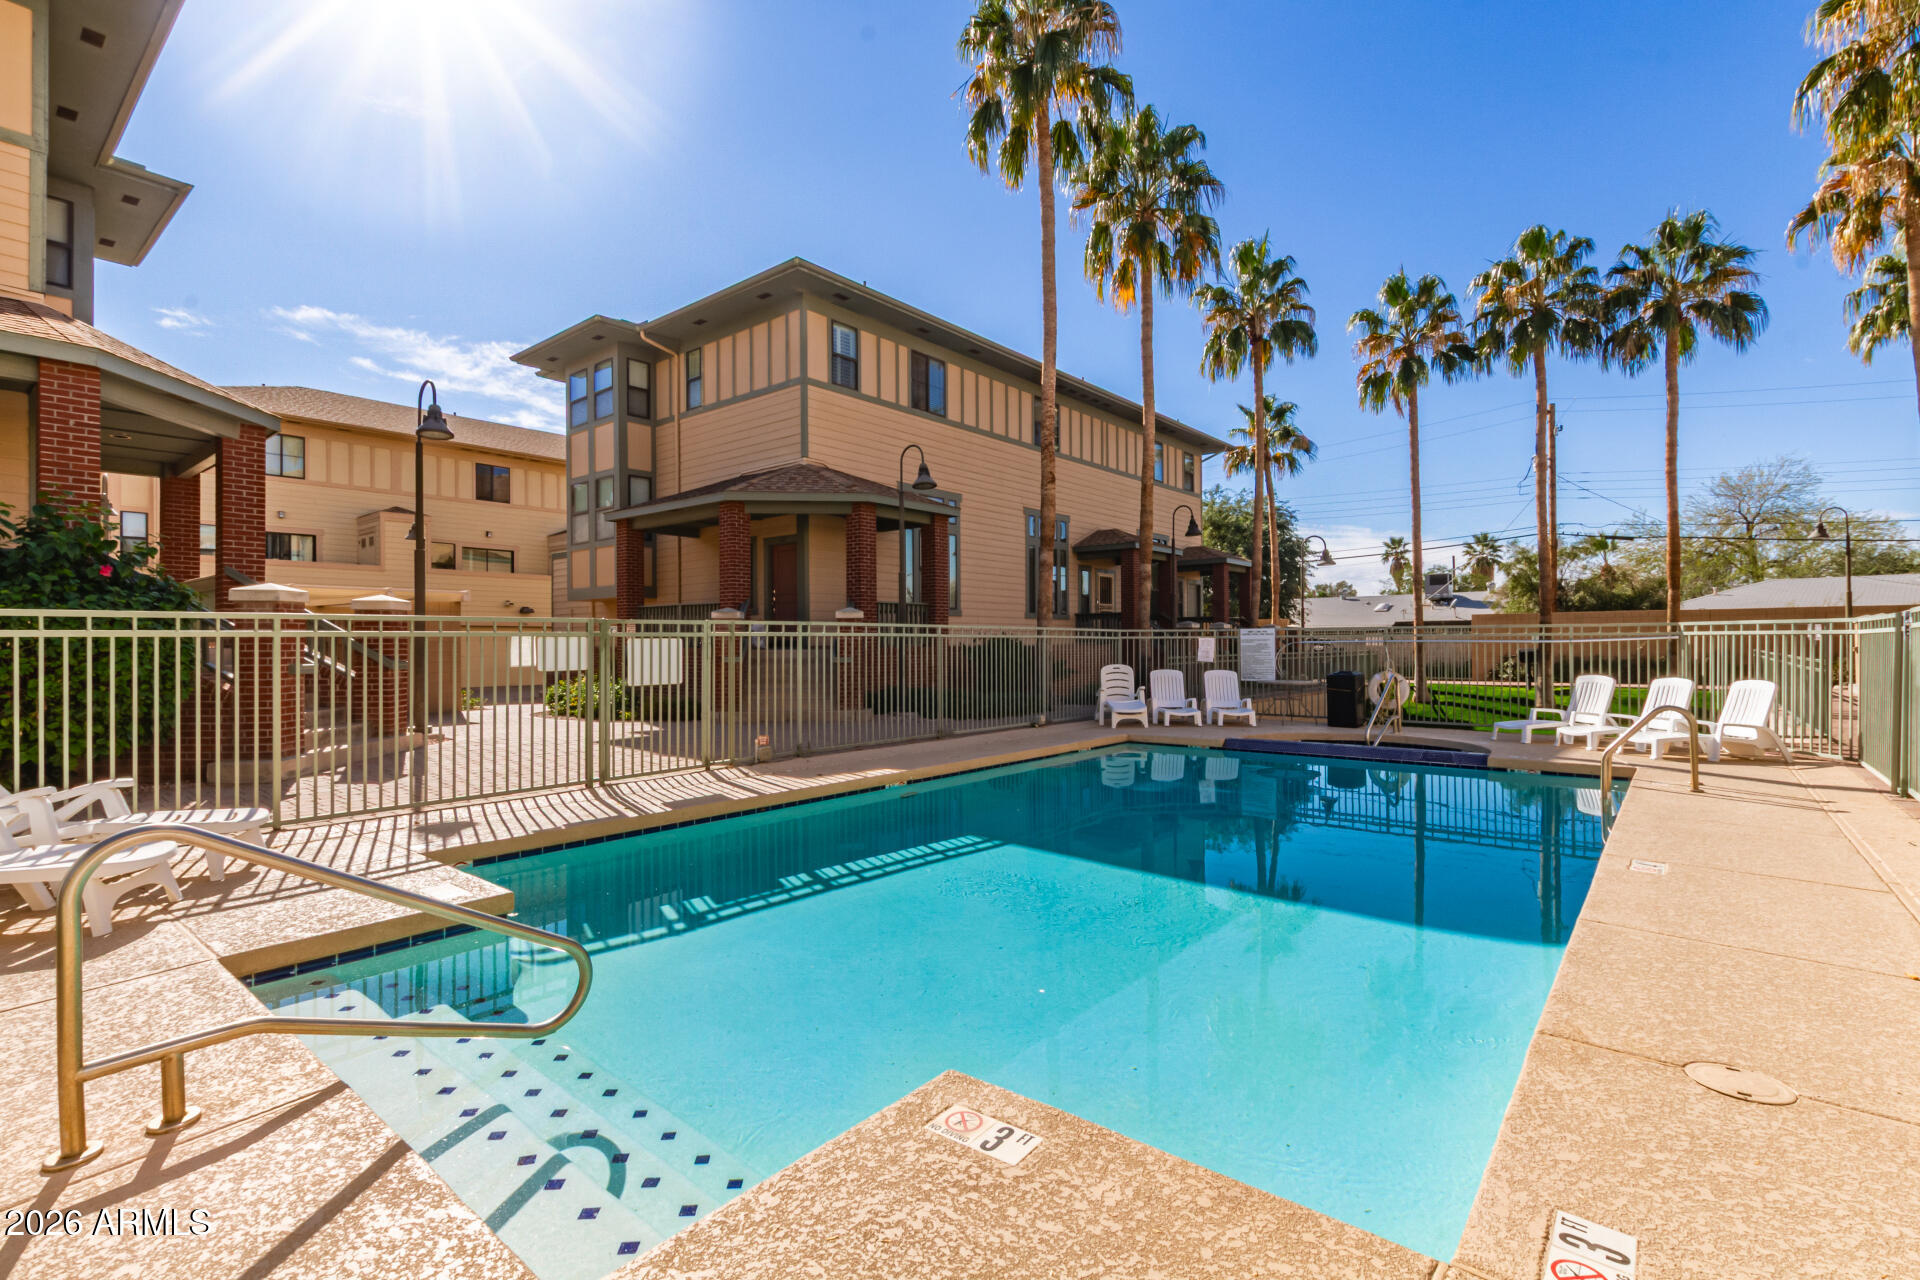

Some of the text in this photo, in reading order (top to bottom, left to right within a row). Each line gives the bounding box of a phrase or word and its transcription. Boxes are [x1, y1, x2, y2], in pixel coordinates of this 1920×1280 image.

[928, 1123, 970, 1143] NO DIVING
[979, 1126, 1036, 1152] 3 FT
[1558, 1216, 1631, 1265] 3 FT
